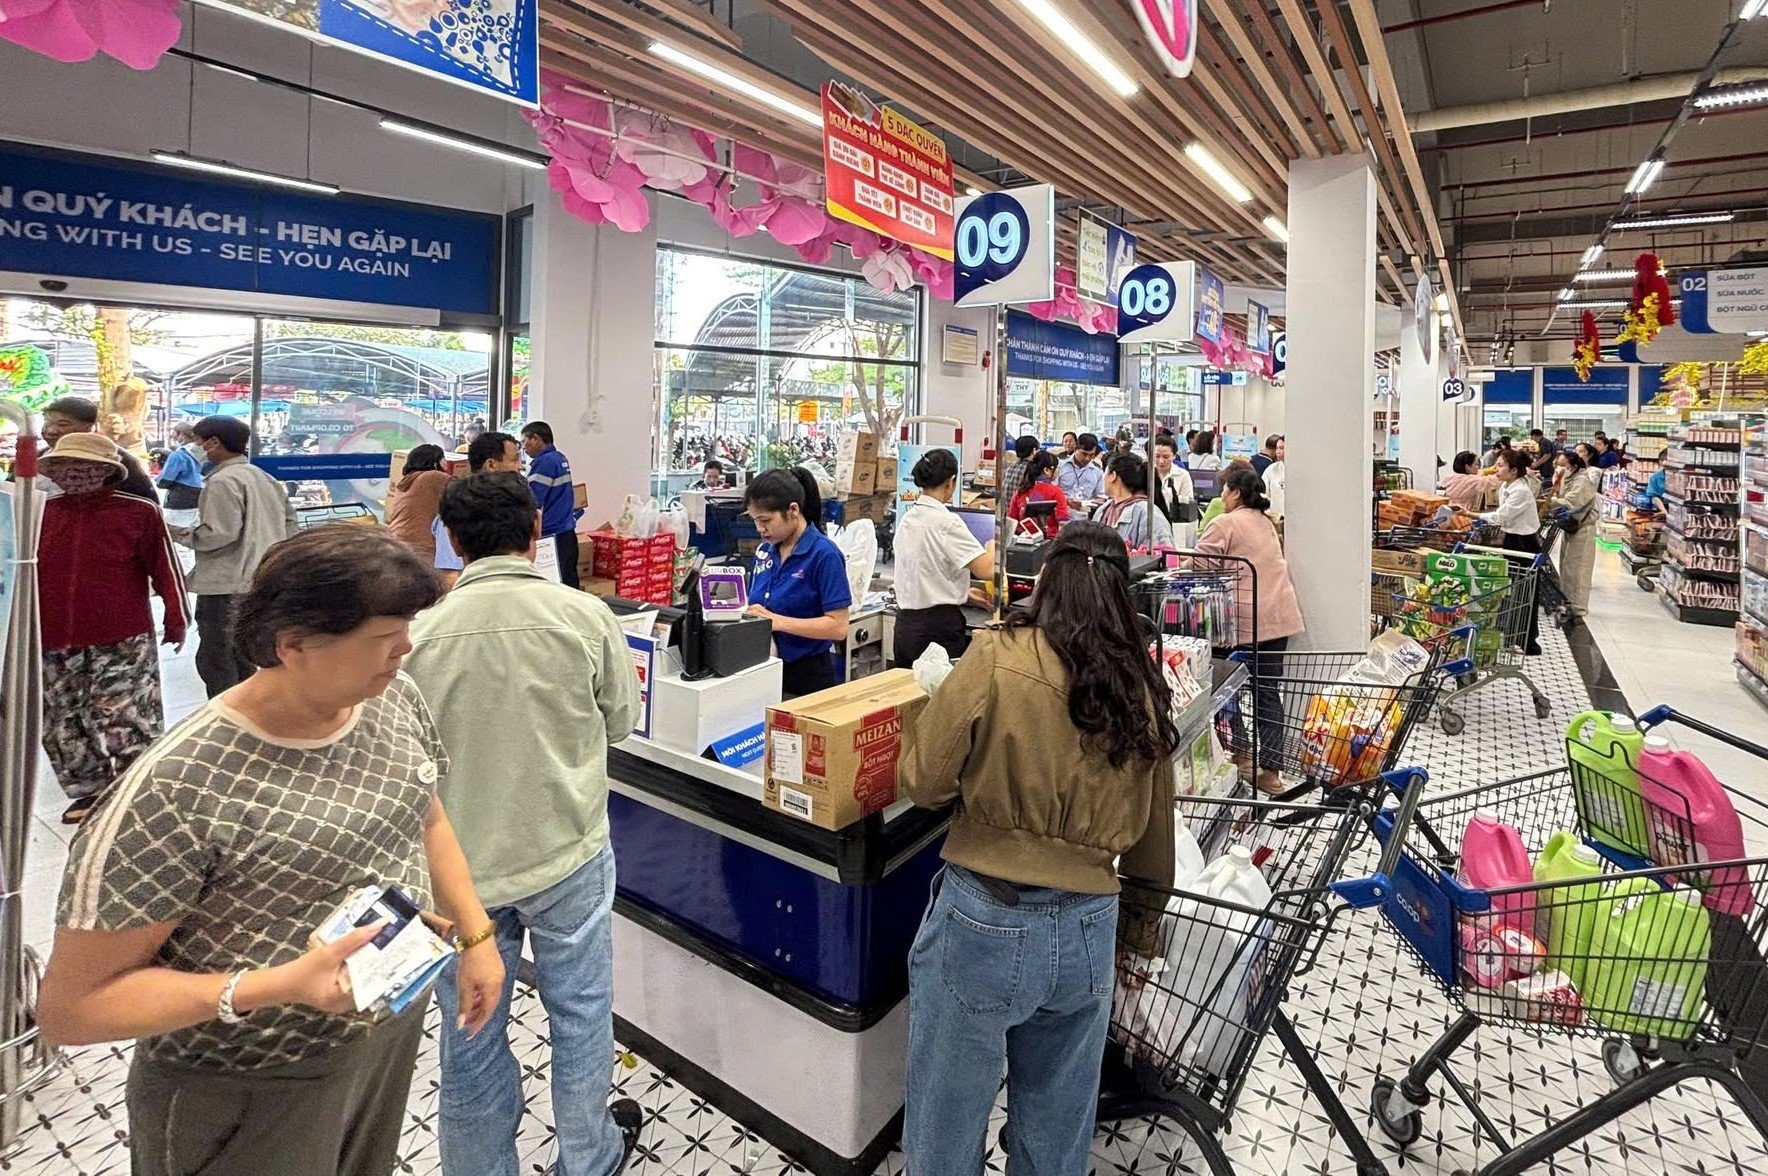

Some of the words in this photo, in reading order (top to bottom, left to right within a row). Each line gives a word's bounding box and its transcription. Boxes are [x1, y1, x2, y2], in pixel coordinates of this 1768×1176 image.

[888, 116, 894, 130] 5
[23, 191, 113, 219] QUÝ
[120, 202, 246, 236] KHÁCH
[277, 221, 341, 249] HẸN
[349, 229, 406, 257] GẶP
[411, 238, 450, 263] LẠI
[0, 219, 47, 240] NG
[55, 224, 142, 250] WITH
[153, 235, 192, 254] US
[220, 243, 272, 264] SEE
[278, 249, 331, 269] YOU
[338, 257, 410, 278] AGAIN
[957, 211, 1021, 268] 09
[1682, 278, 1706, 292] 02
[1121, 277, 1170, 316] 08
[1445, 383, 1462, 394] 03
[1438, 560, 1455, 568] MILO
[735, 736, 759, 752] KHÁCH
[855, 719, 901, 747] MEIZAN
